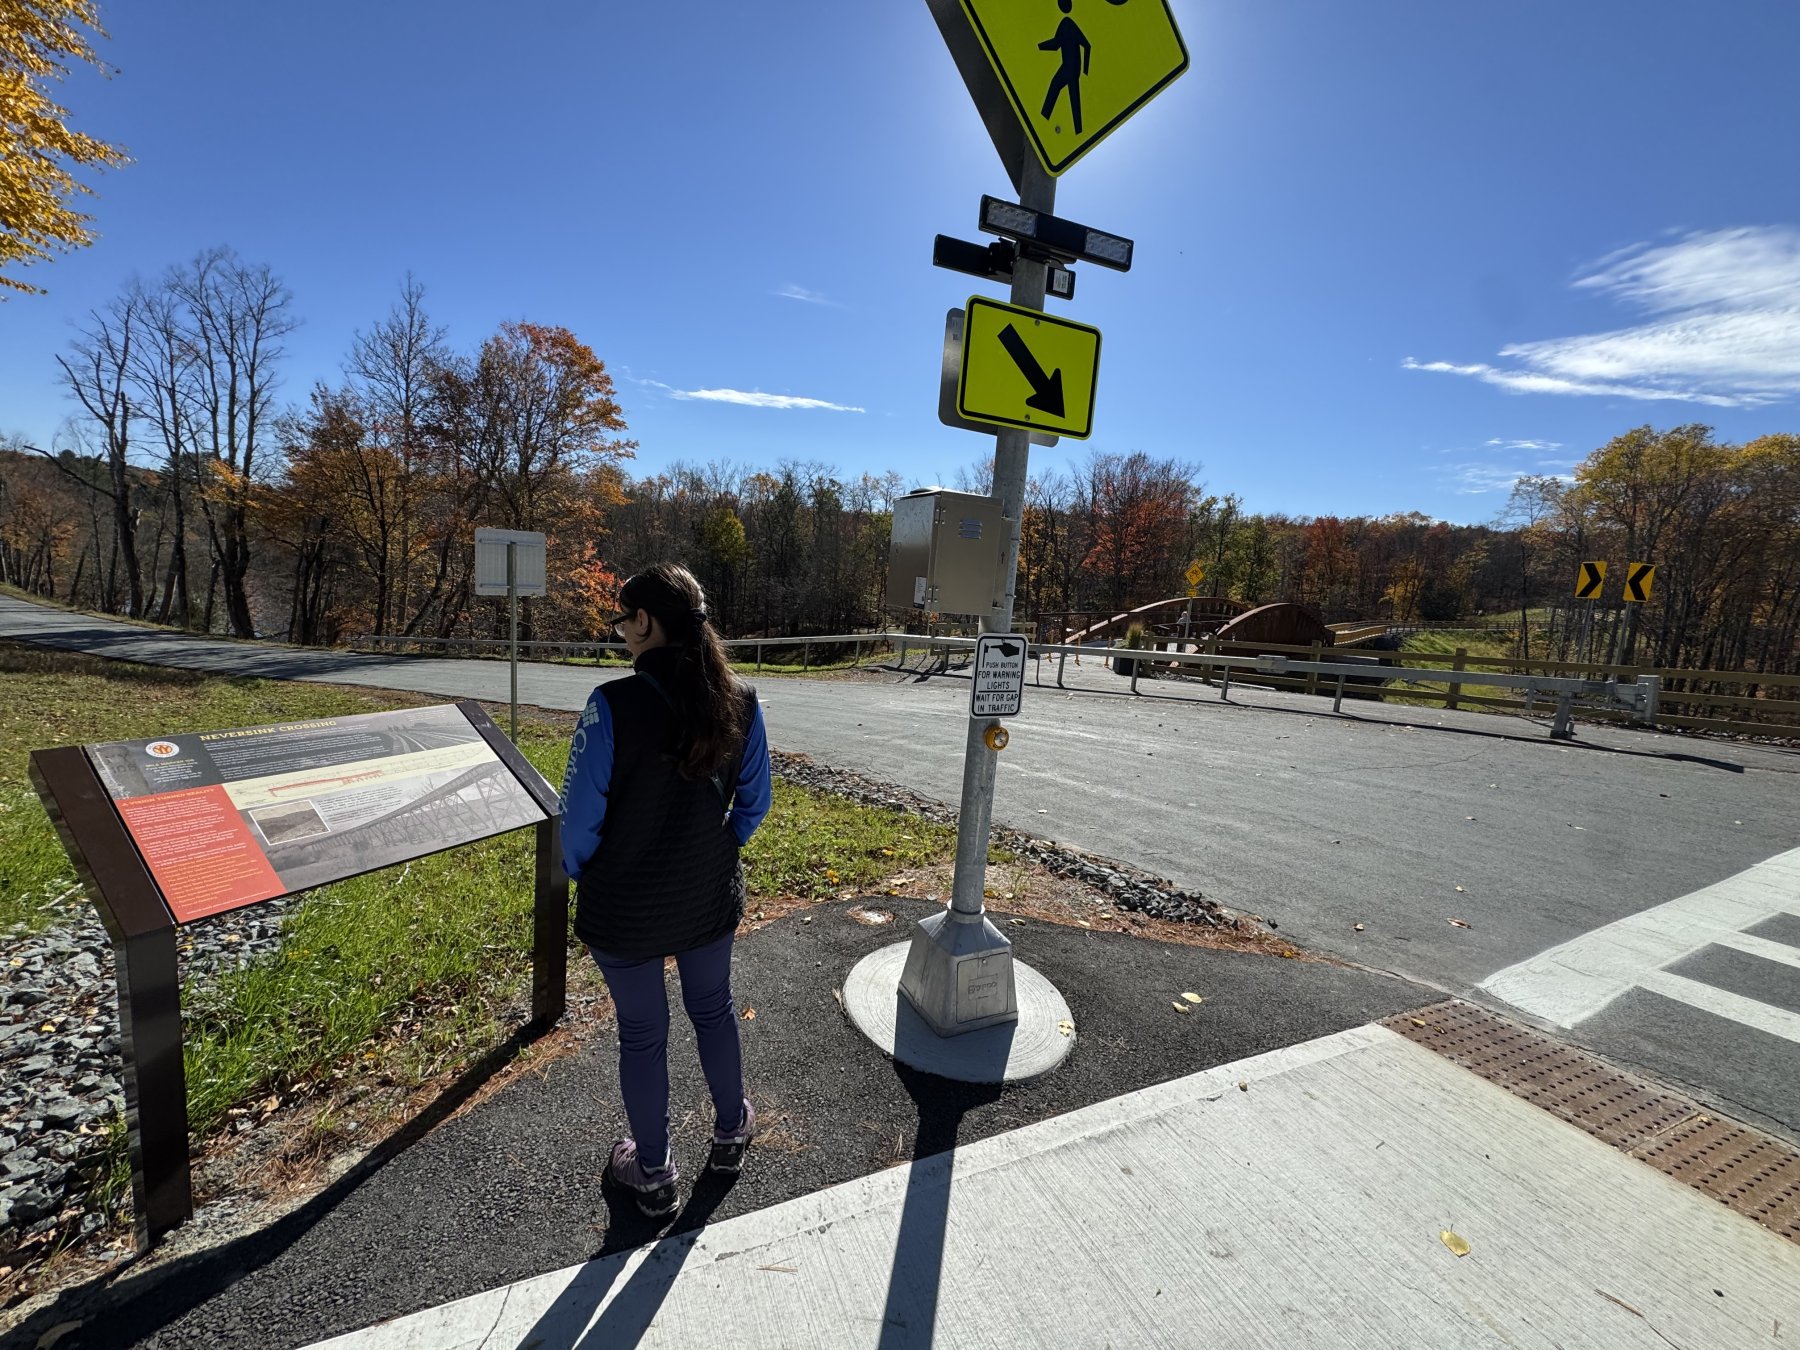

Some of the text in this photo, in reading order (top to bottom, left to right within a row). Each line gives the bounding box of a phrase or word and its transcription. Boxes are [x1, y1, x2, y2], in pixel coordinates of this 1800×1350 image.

[978, 670, 1020, 679] FOR WARNING
[986, 682, 1010, 690] LIGHTS
[976, 694, 1019, 702] WAIT FOR GAP
[978, 704, 1015, 712] IN TRAFFIC
[200, 727, 276, 741] NEVERSINK
[279, 720, 337, 732] CROSSING
